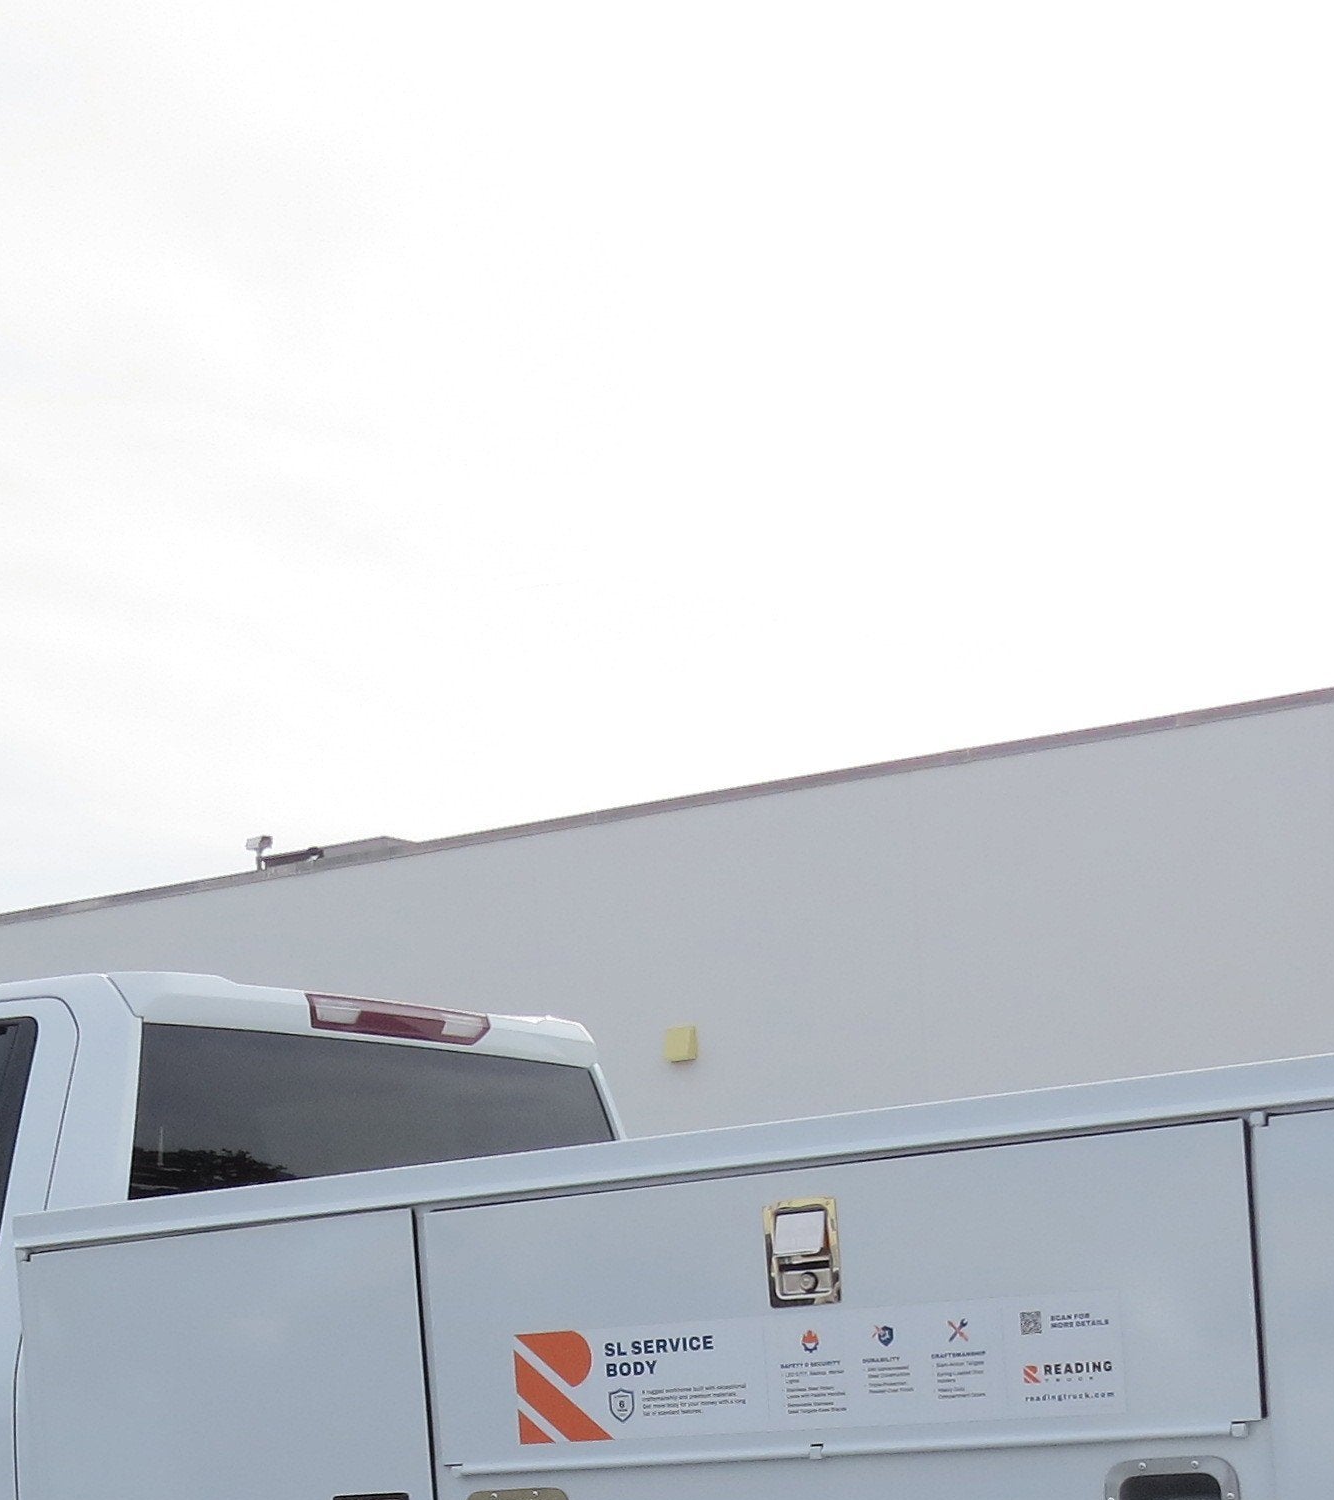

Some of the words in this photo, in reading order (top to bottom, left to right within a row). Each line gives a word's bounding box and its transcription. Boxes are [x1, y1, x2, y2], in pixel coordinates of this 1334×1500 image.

[604, 1342, 627, 1357] SL
[631, 1335, 714, 1355] SERVICE
[606, 1360, 657, 1378] BODY
[1043, 1361, 1113, 1376] READING
[1025, 1392, 1115, 1402] readingtruck.com
